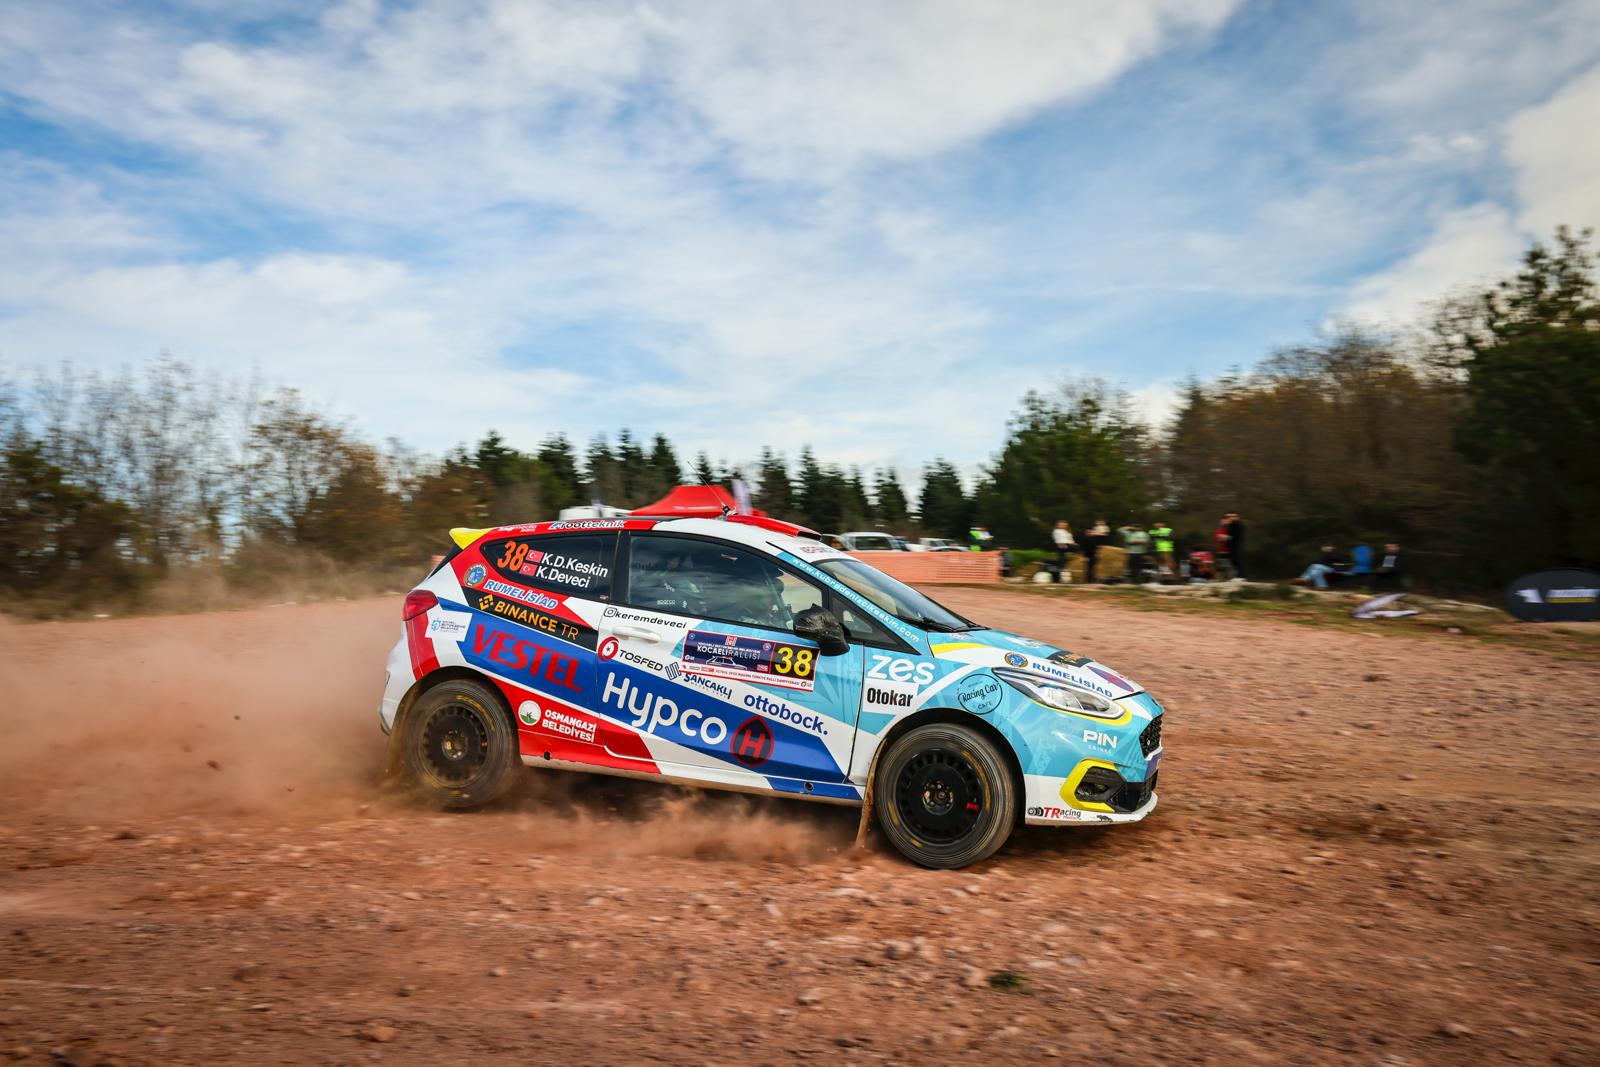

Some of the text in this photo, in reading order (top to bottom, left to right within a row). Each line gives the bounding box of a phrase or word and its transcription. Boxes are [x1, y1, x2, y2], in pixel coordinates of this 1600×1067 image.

[497, 540, 529, 571] 38
[541, 552, 608, 578] K.D.Keskin
[535, 565, 591, 588] K.Deveci
[494, 601, 558, 633] BINANCE
[561, 622, 579, 640] TR
[614, 610, 687, 629] keremdeveci
[473, 623, 582, 692] VESTEL
[620, 649, 663, 672] TOSFED
[775, 646, 813, 677] 38
[867, 654, 936, 686] zes
[683, 673, 733, 700] SANCAKLI
[866, 687, 914, 707] Otokar
[962, 688, 986, 703] Racing
[985, 682, 999, 694] Car
[544, 708, 597, 733] OSMANGAZİ
[602, 671, 728, 745] Hypco
[541, 718, 595, 743] BELEDİYESİ
